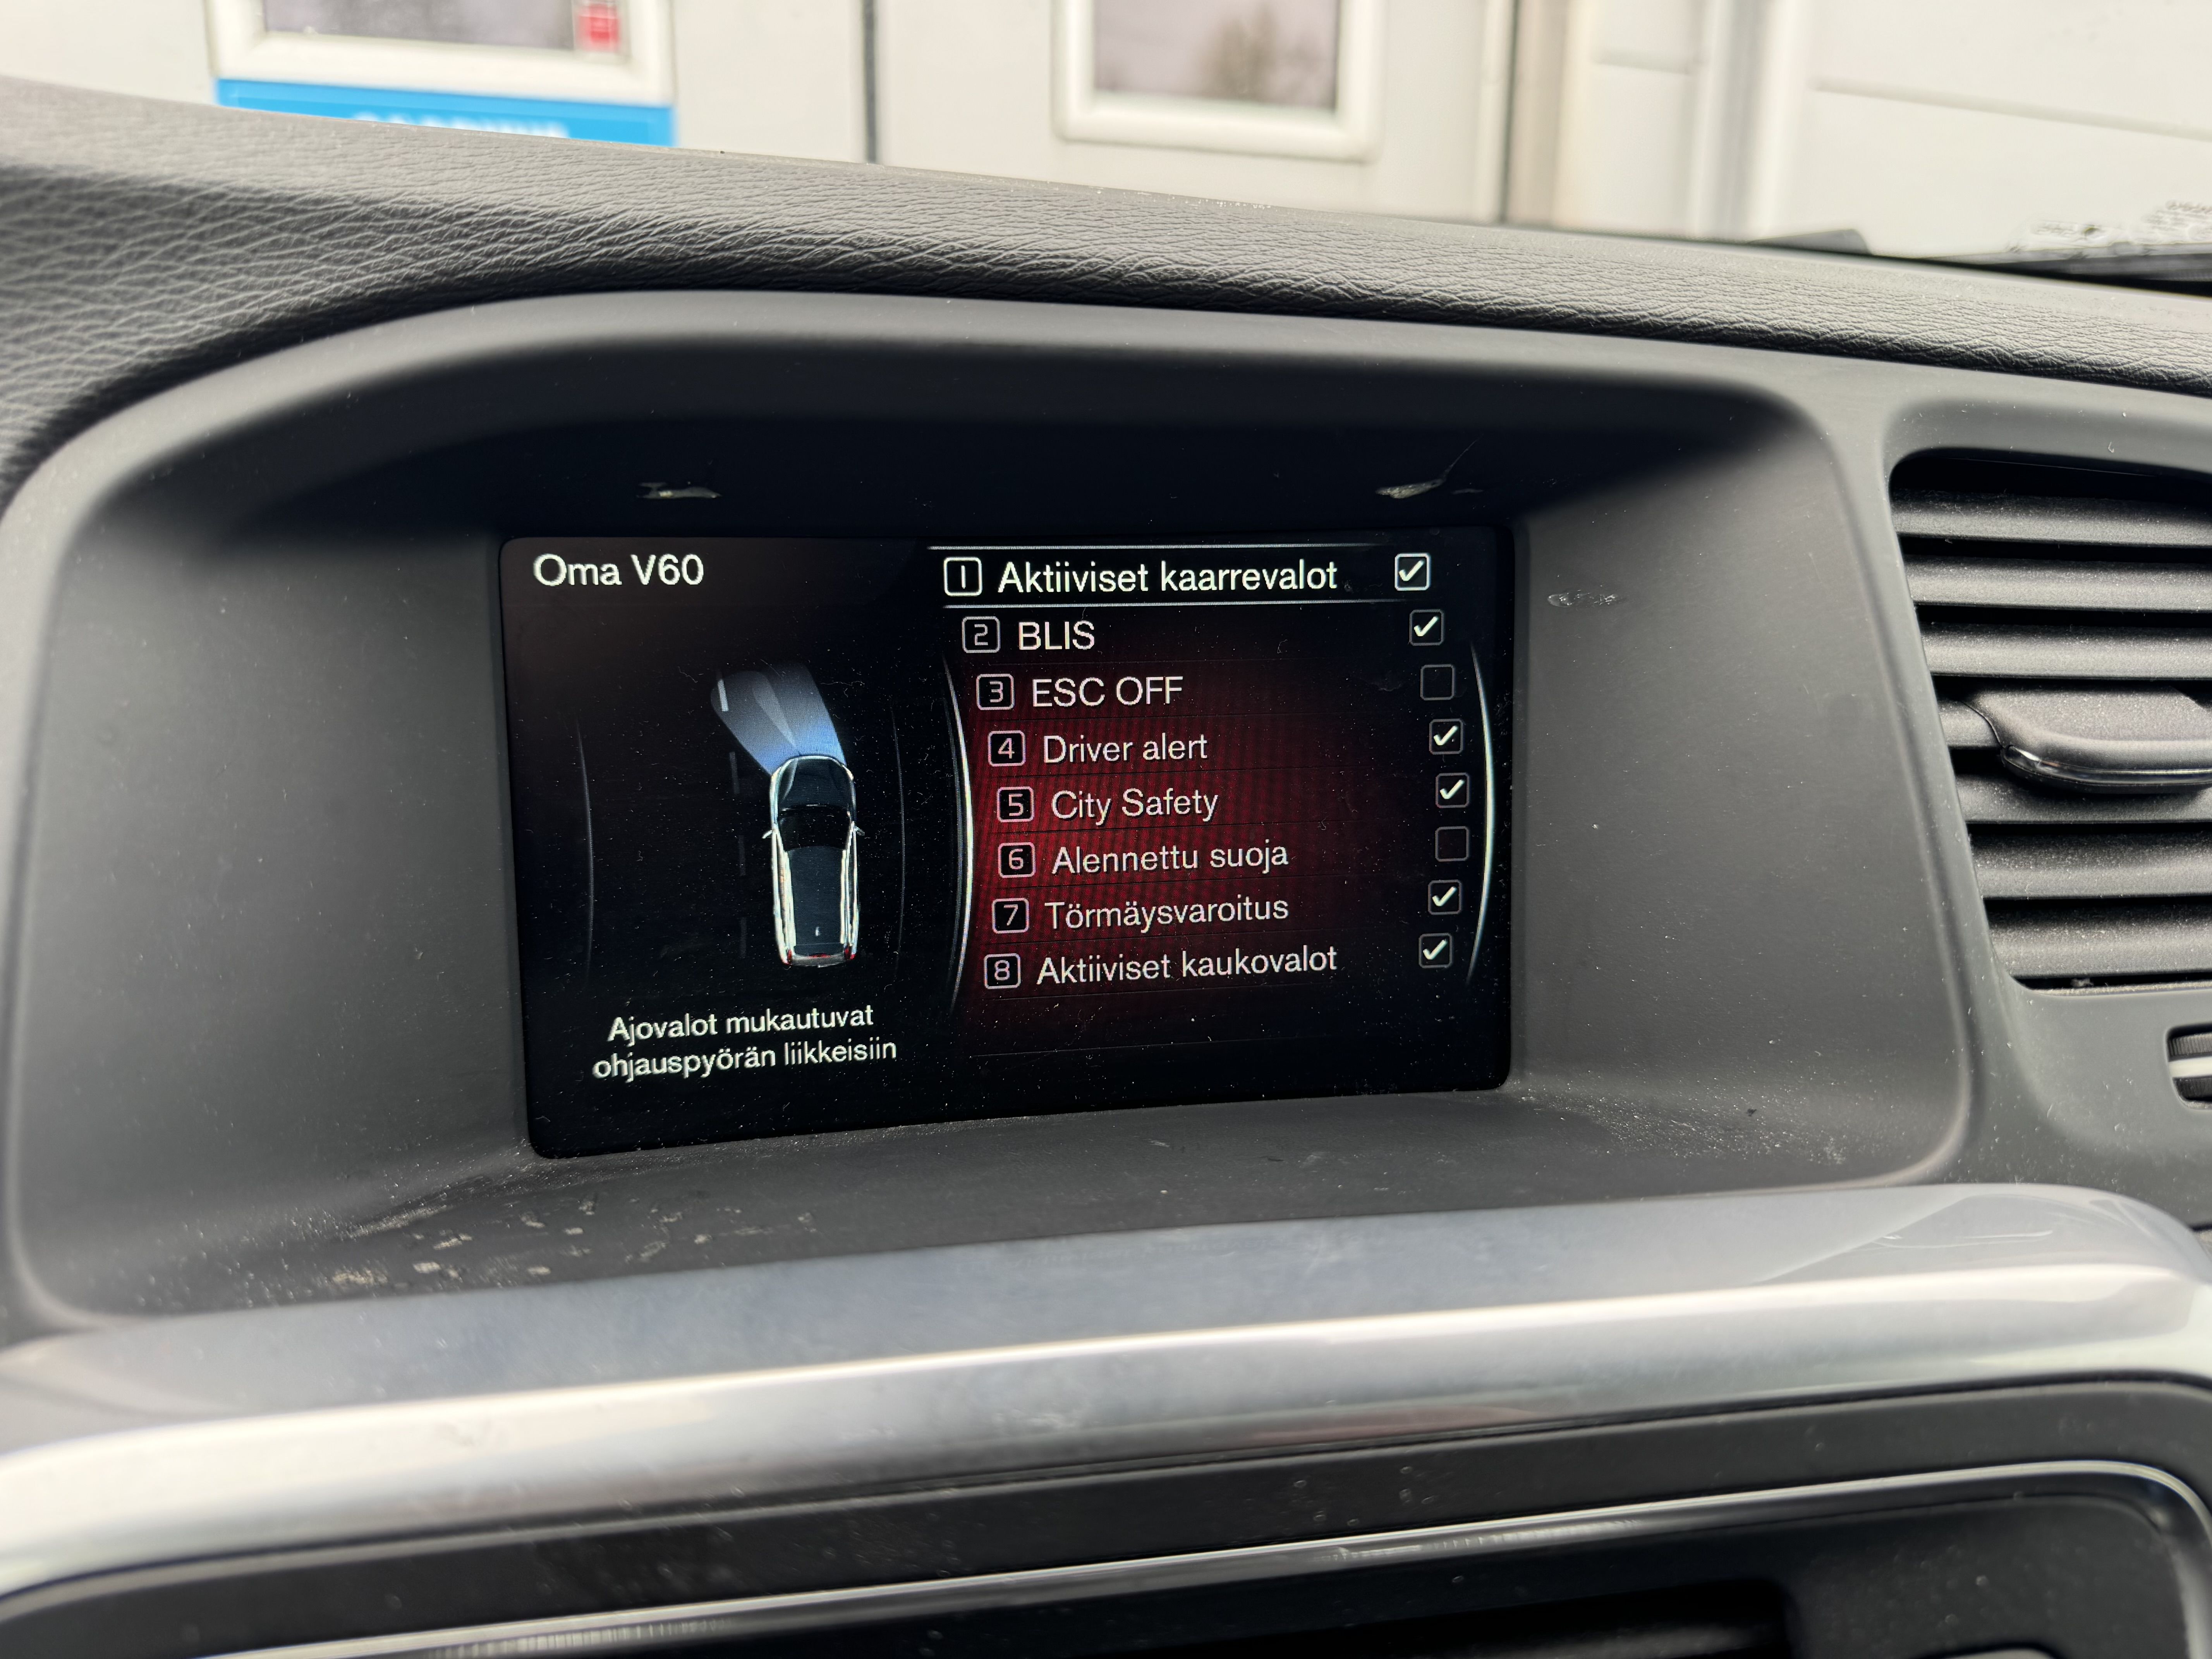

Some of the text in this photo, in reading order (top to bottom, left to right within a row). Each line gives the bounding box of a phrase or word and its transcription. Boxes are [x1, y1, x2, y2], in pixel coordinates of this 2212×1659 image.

[534, 553, 704, 586] Oma V60
[998, 561, 1148, 593] Aktiiviset
[1161, 559, 1337, 591] kaarrevalot
[975, 620, 1094, 650] 2 BLIS
[990, 676, 1183, 707] 3 ESC OFF
[998, 732, 1207, 763] 4 Driver alert
[1008, 788, 1218, 826] 5 City Safety
[1009, 839, 1288, 874] 6 Alennettu suoja
[1004, 896, 1288, 933] 7 Törmäysvaroitus
[994, 945, 1336, 985] 8 Aktiiviset kaukovalot
[608, 1005, 873, 1047] Ajovalot mukautuvat
[594, 1037, 896, 1083] ohjauspyörän liikkeisiin
